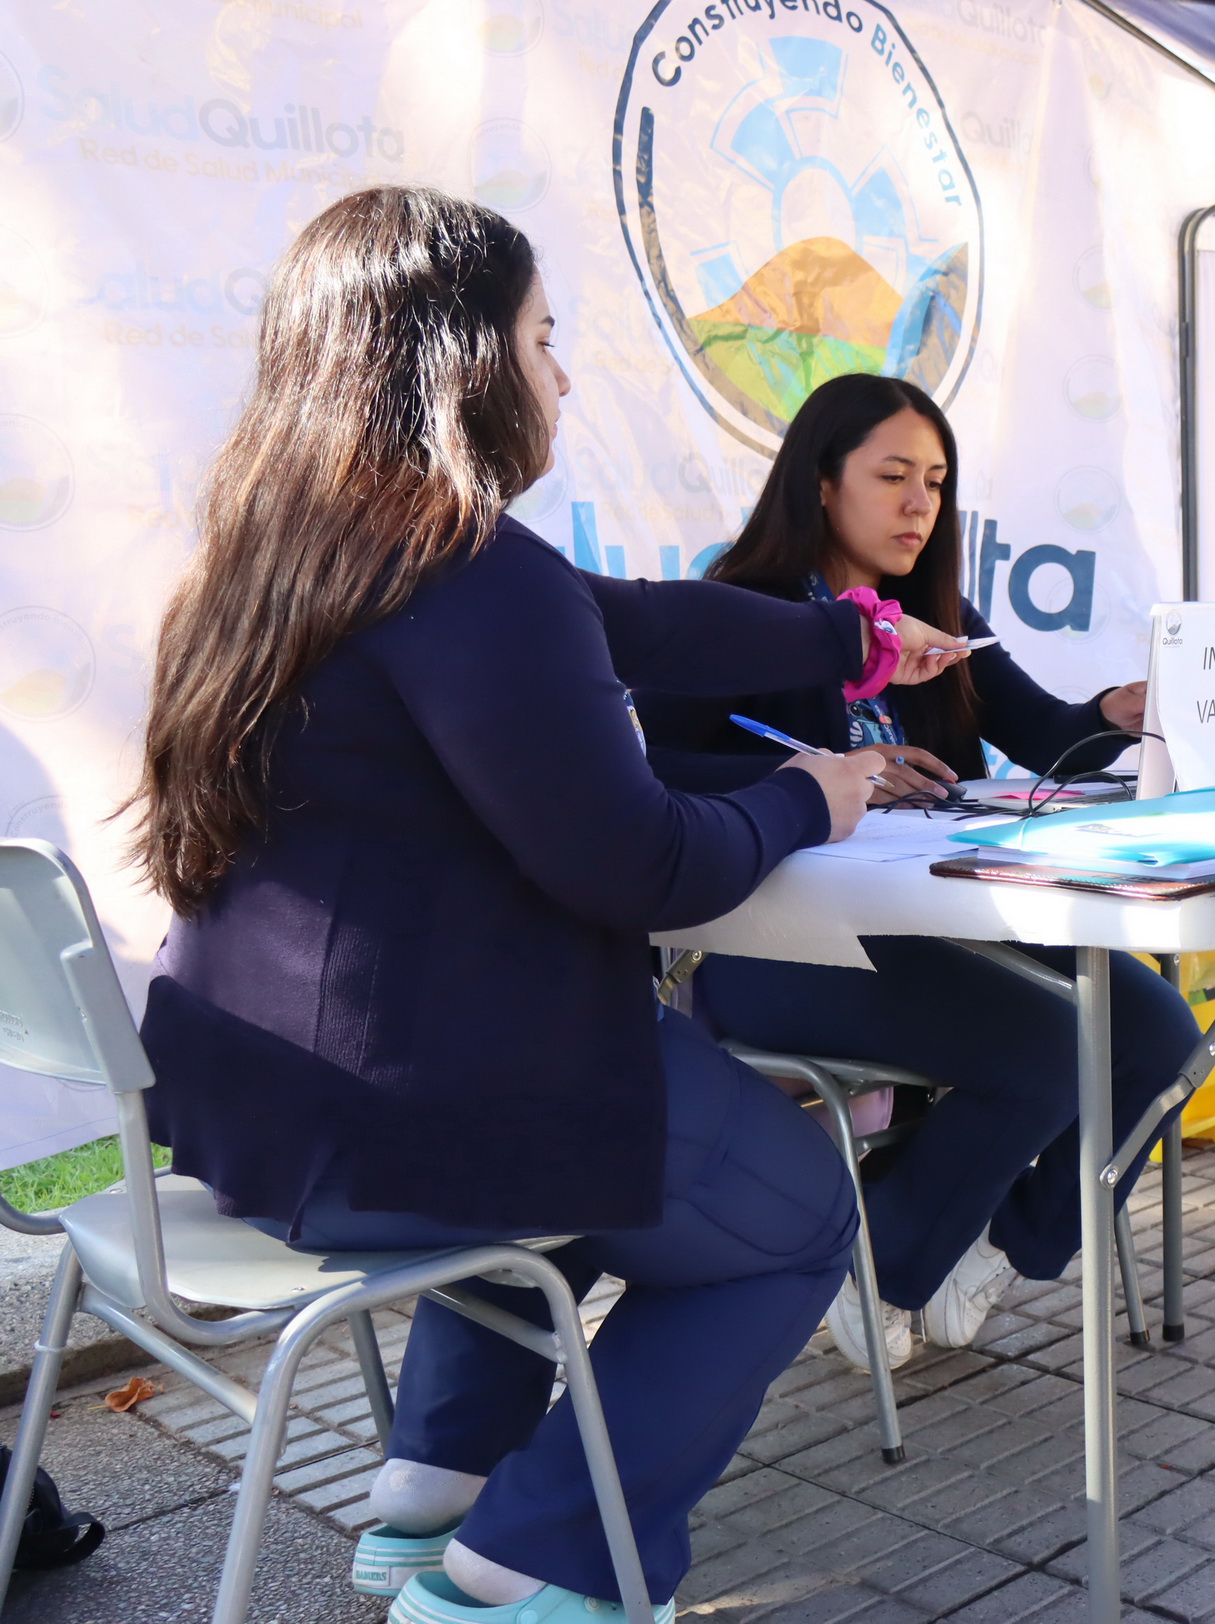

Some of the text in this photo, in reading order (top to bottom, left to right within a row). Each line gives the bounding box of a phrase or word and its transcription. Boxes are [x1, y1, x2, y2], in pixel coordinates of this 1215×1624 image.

[36, 64, 405, 164] SaludQuillota
[870, 23, 962, 207] Bienestar
[79, 137, 137, 167] Red
[143, 149, 179, 174] de
[185, 153, 259, 184] Salud
[103, 320, 163, 348] Red
[172, 323, 206, 348] de
